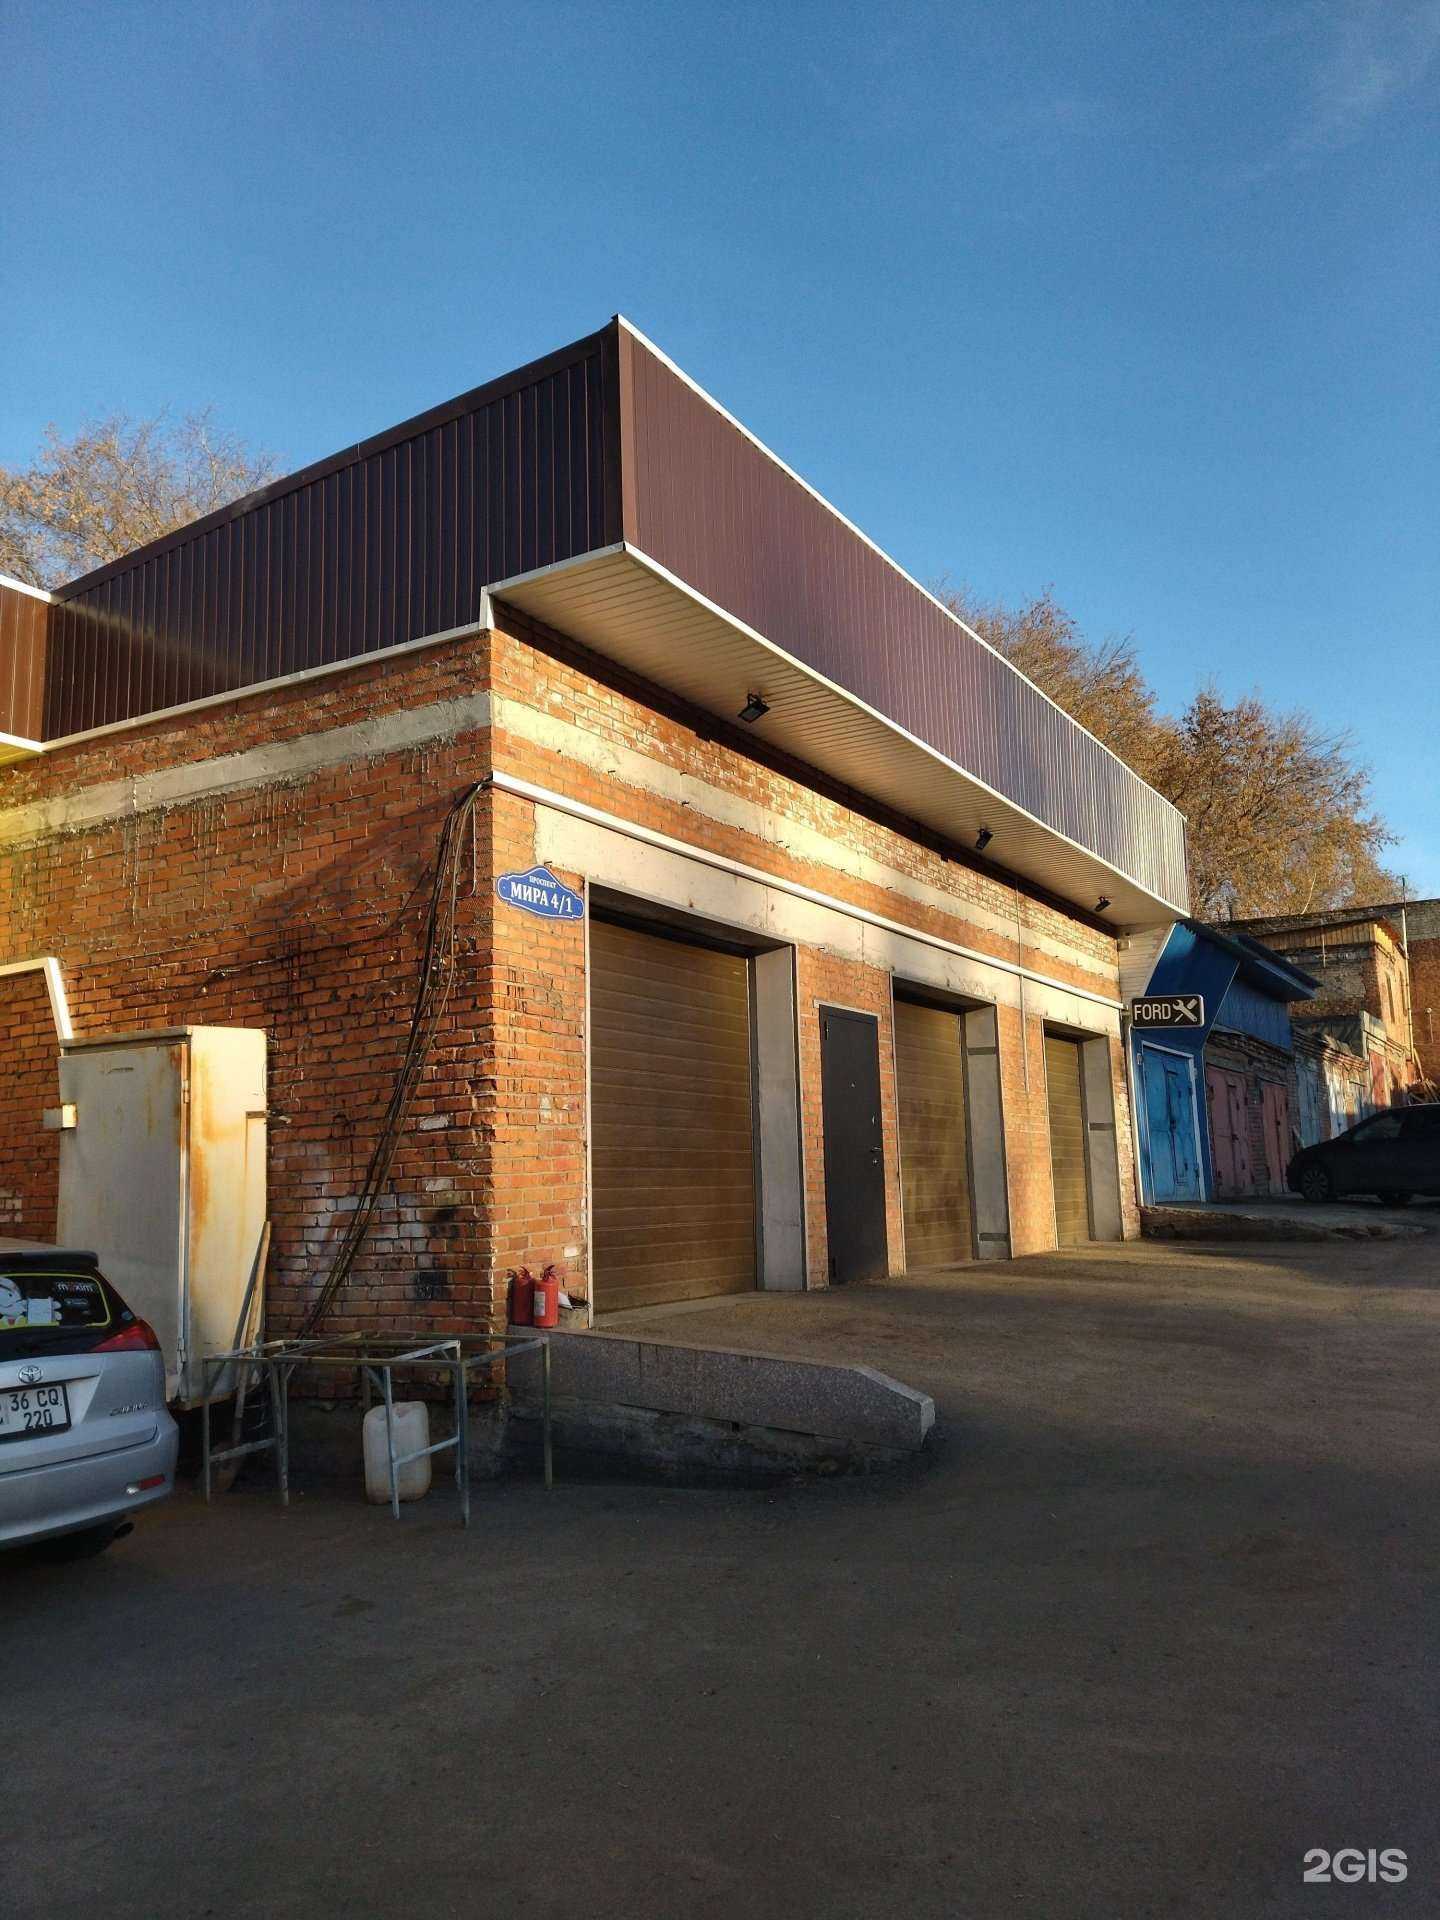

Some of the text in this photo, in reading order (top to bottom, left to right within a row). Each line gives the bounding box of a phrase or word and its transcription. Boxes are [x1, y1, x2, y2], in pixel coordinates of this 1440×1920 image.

[529, 875, 557, 888] ПРОСПЕКТ
[510, 881, 573, 914] МИРА 4/1
[1134, 1003, 1171, 1020] FORD
[10, 1388, 59, 1411] 36 CQ
[24, 1408, 53, 1430] 220
